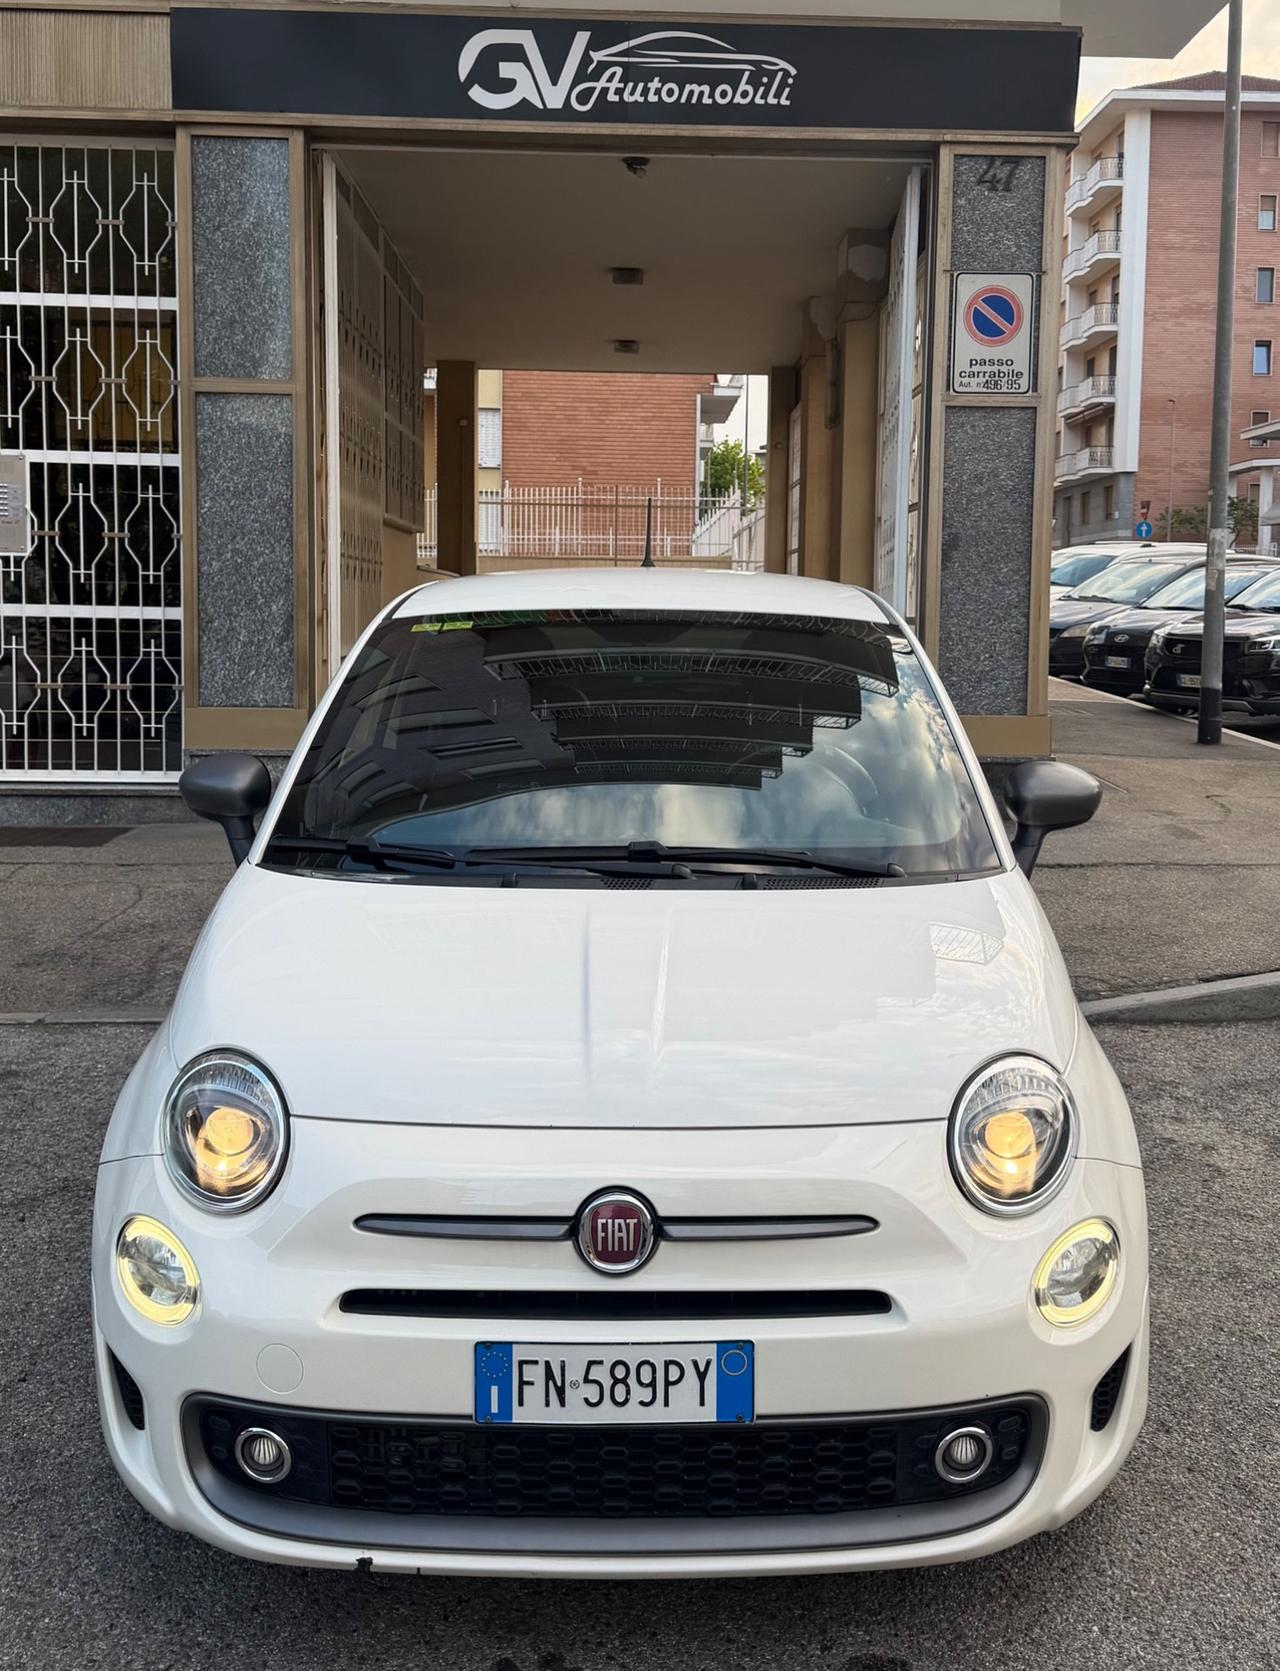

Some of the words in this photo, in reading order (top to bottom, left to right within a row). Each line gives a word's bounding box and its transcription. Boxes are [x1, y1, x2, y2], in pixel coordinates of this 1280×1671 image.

[458, 28, 592, 110] GV
[570, 66, 794, 112] Automobili
[976, 156, 1019, 191] 47
[958, 369, 1024, 379] carrabile
[969, 358, 1014, 369] passo
[597, 1218, 638, 1251] FIAT
